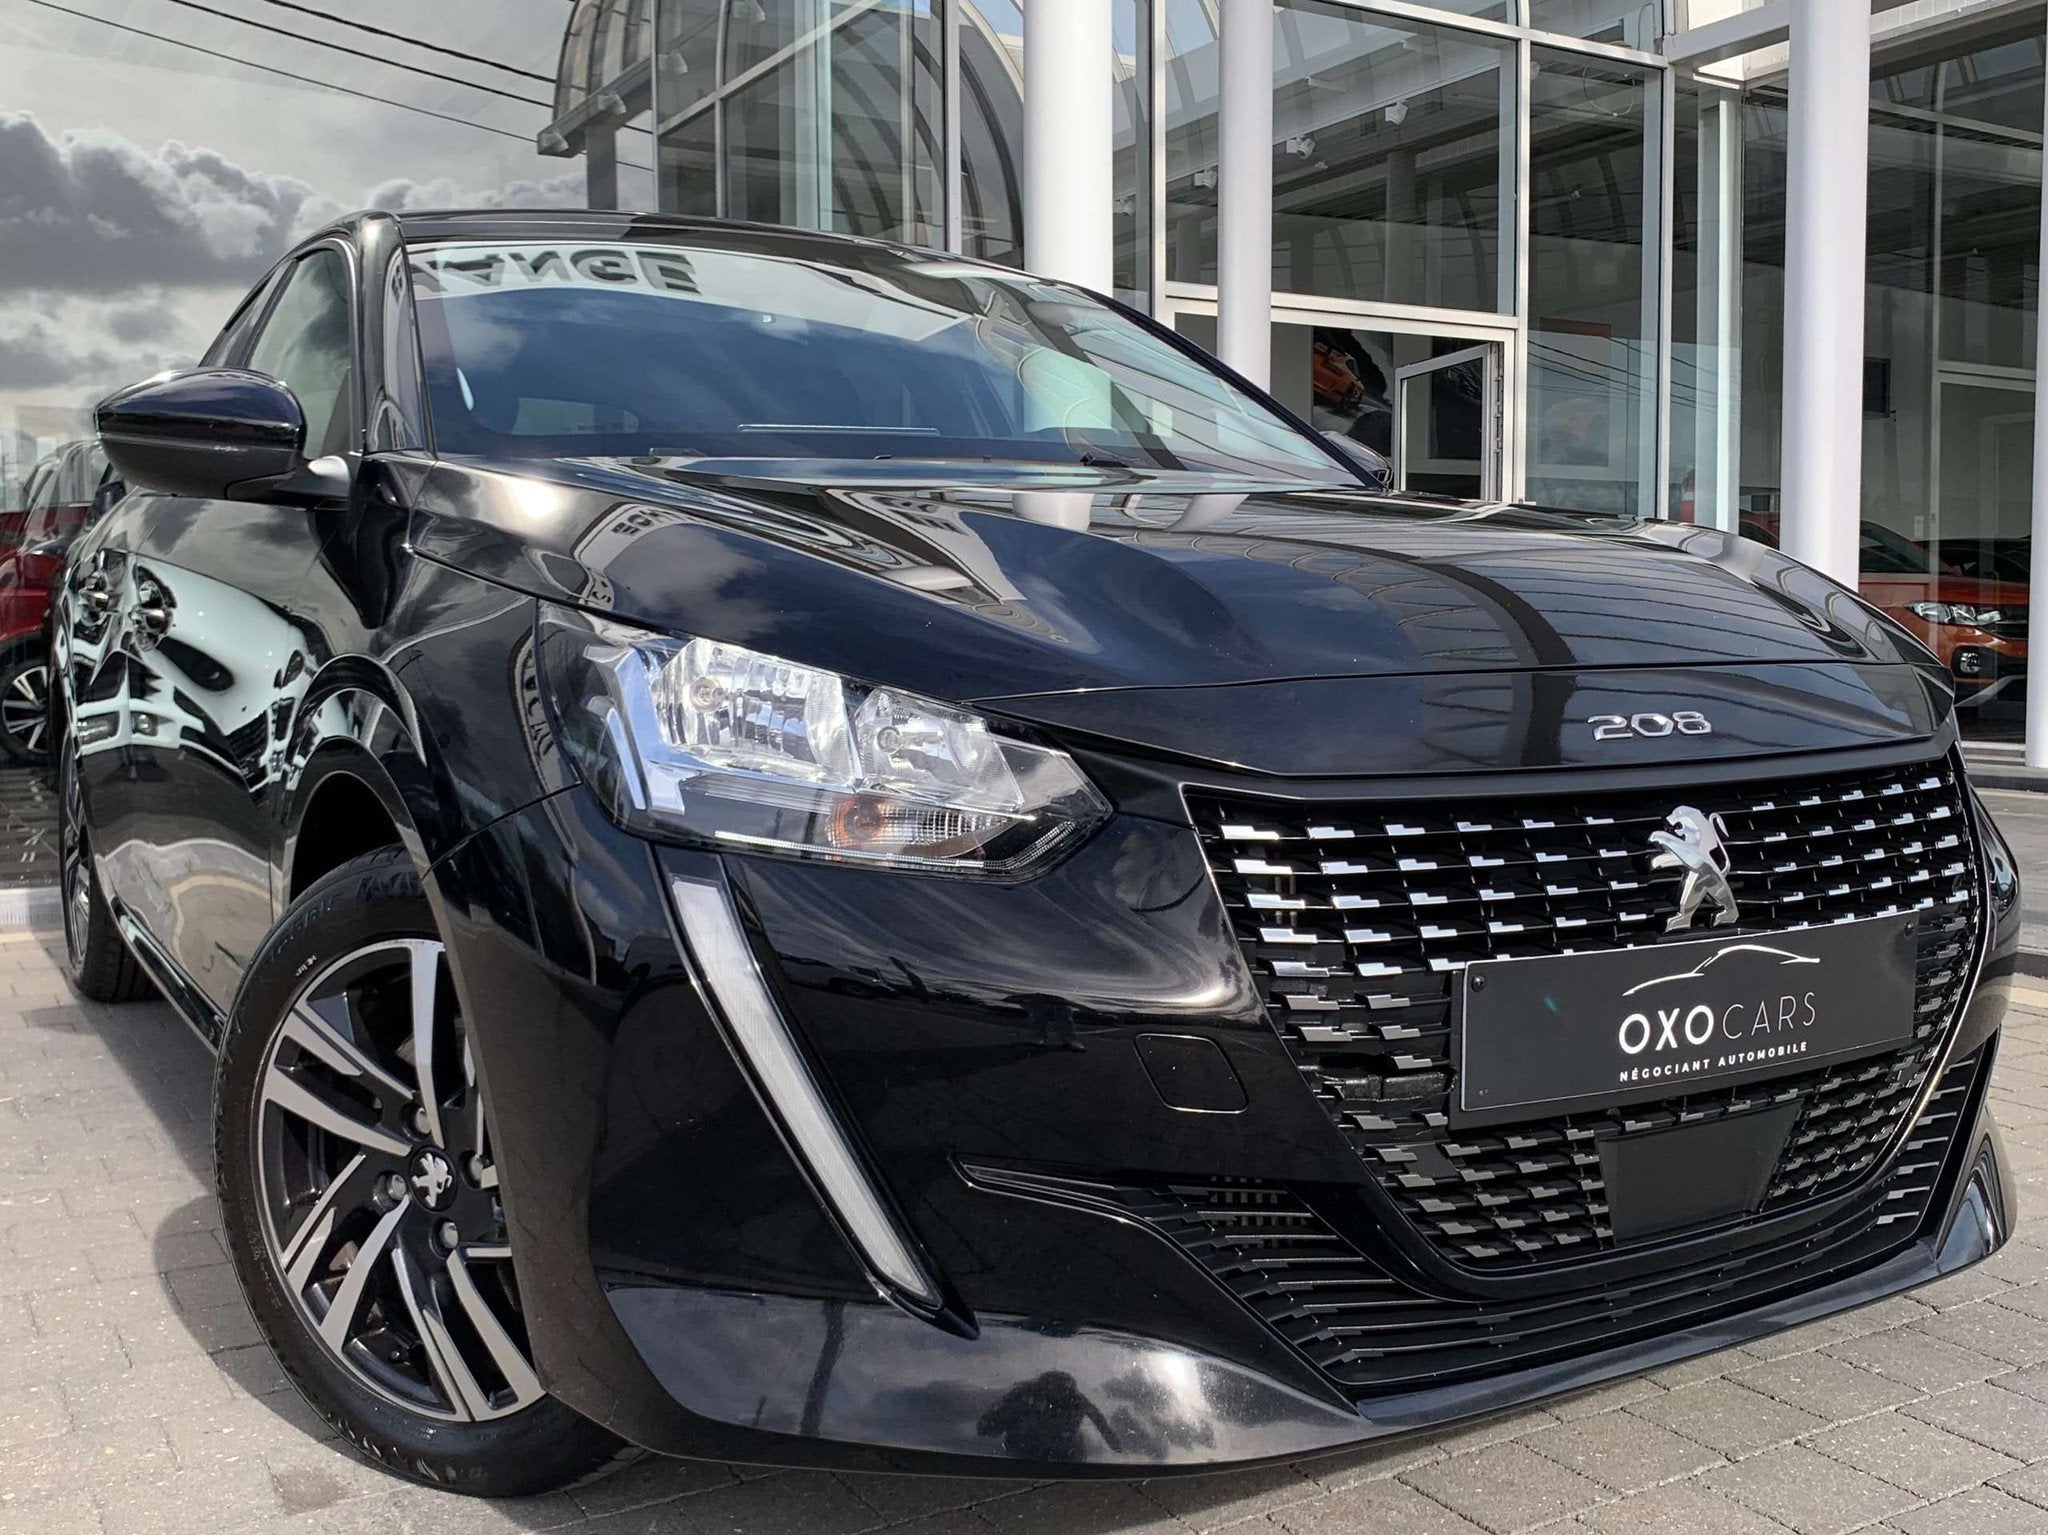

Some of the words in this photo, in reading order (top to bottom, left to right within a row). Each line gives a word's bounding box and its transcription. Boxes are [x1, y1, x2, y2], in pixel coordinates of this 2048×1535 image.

[1587, 711, 1712, 741] 208
[1619, 1059, 1710, 1082] NÉGOCIANT
[1718, 1041, 1808, 1067] AUTOMOBILE
